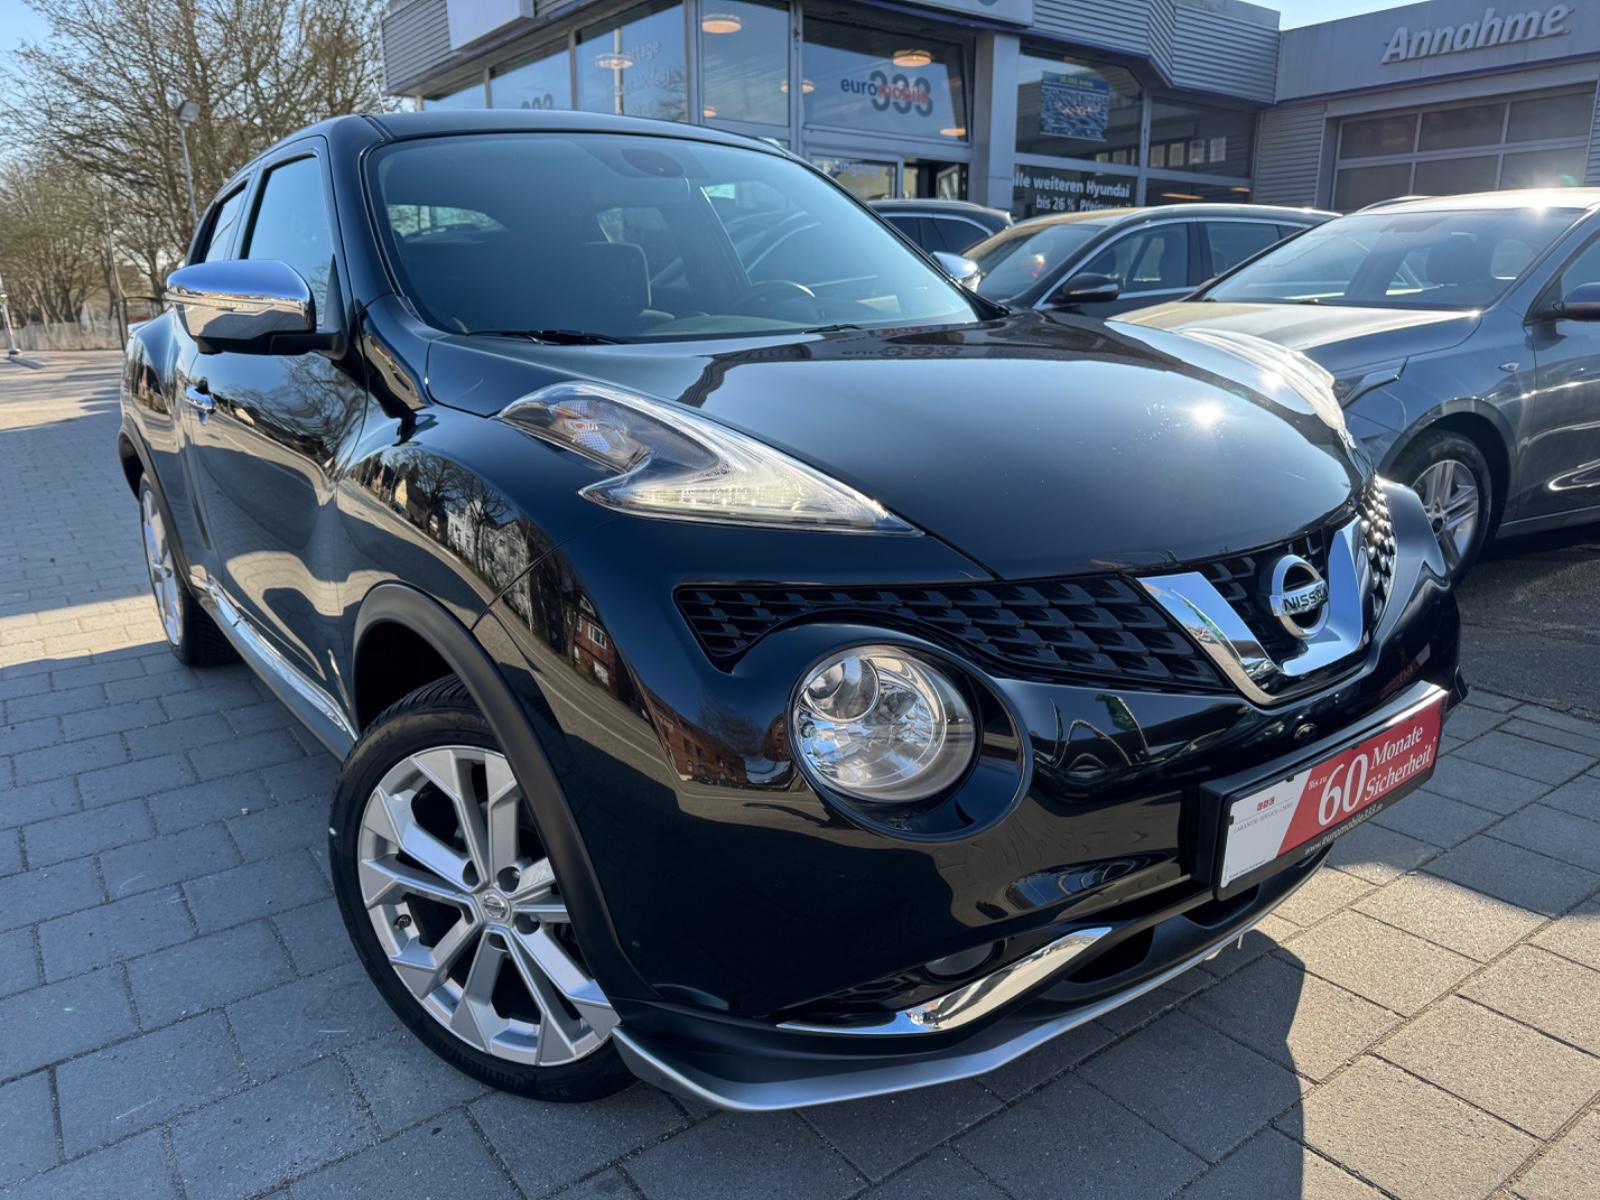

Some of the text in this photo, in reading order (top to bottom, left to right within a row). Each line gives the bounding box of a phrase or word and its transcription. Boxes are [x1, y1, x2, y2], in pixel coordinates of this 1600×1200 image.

[1380, 4, 1571, 65] Annahme
[1033, 176, 1084, 193] weiteren
[1086, 180, 1131, 198] Hyundai
[1036, 194, 1051, 209] bis
[1369, 726, 1424, 770] Monate
[1318, 753, 1369, 826] 60
